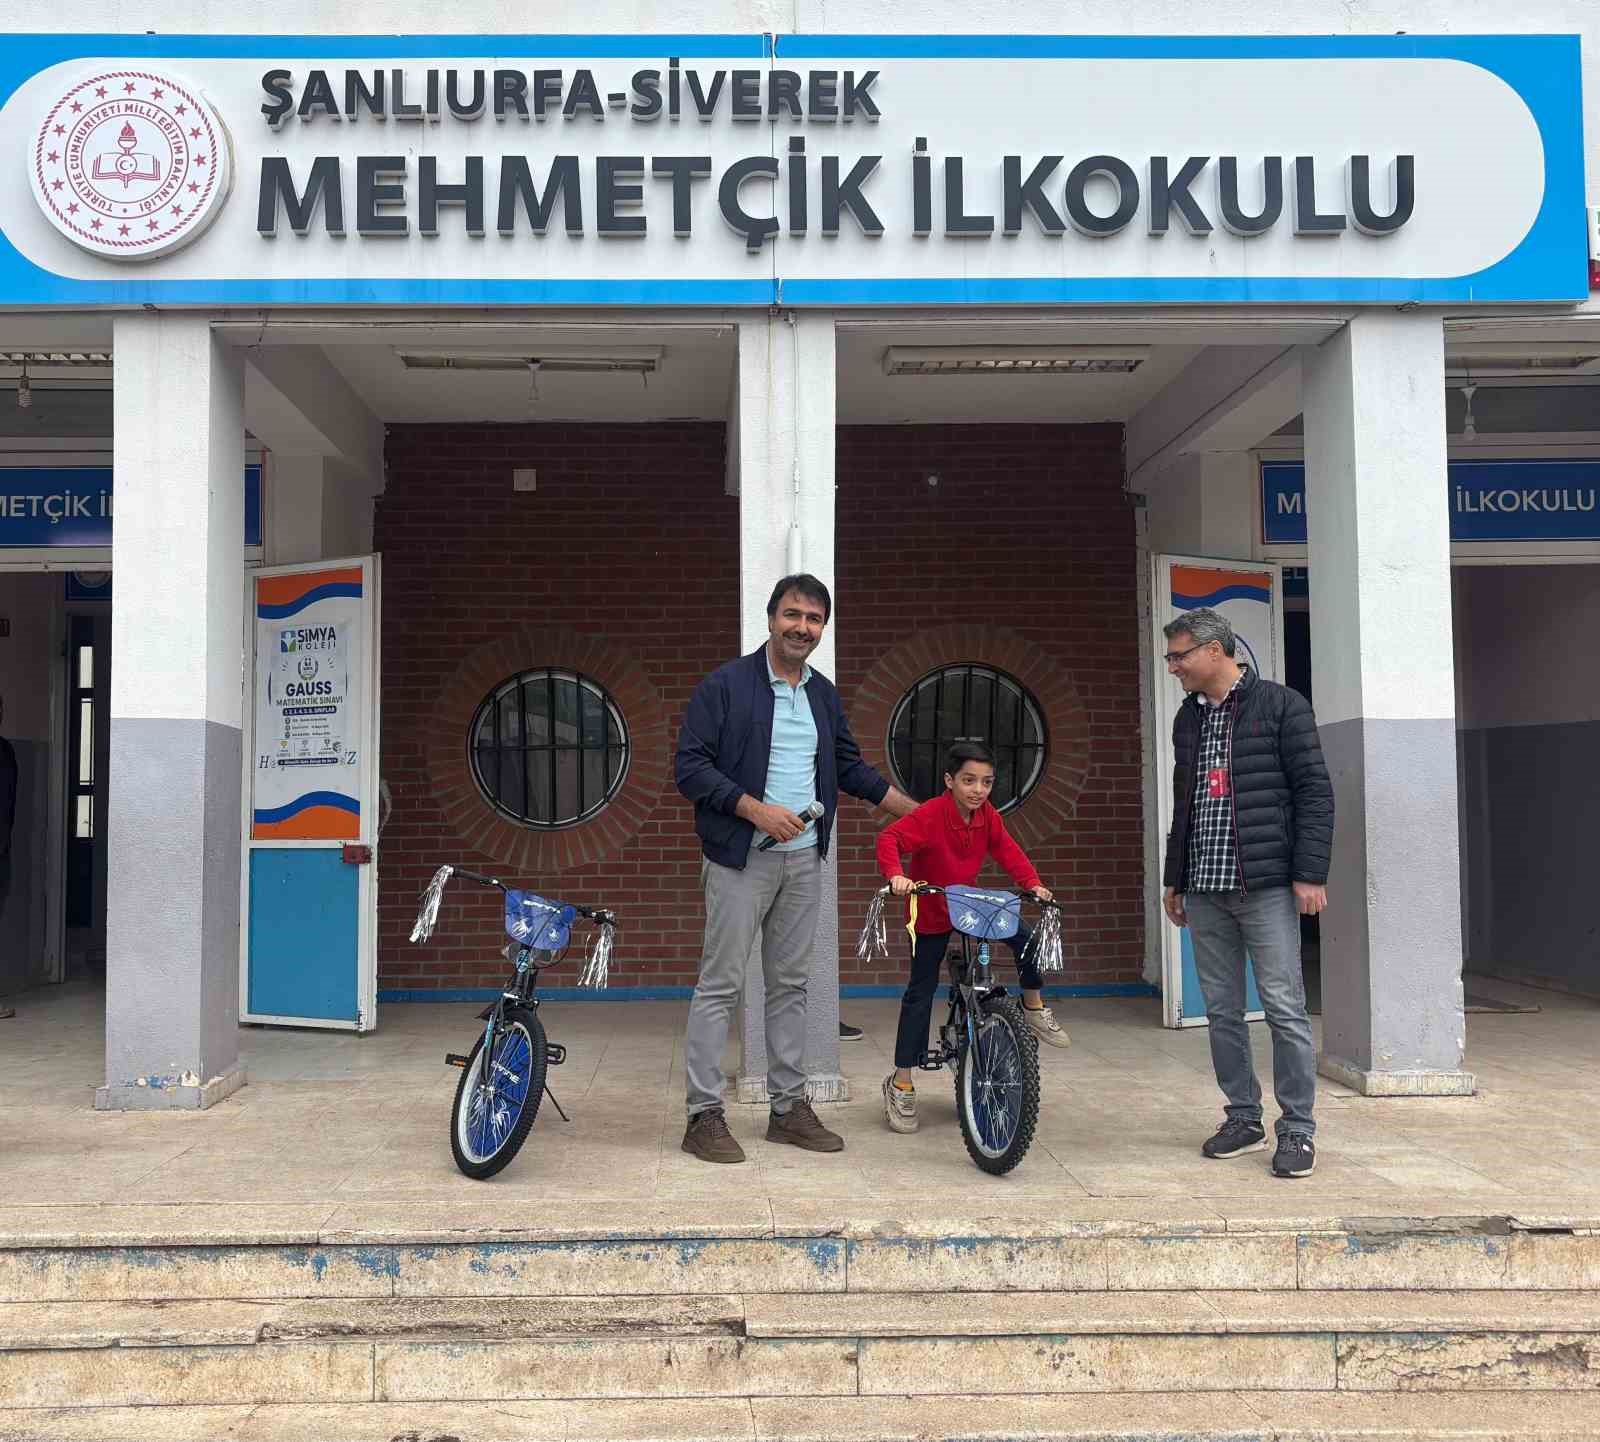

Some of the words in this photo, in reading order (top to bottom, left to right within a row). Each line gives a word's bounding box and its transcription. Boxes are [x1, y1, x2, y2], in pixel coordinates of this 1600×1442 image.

[261, 56, 882, 127] ŞANLIURFA-SİVEREK
[70, 104, 120, 170] CUMHURİYETİ
[158, 116, 184, 154] EĞİTİM
[257, 136, 885, 249] MEHMETÇİK
[912, 136, 1415, 235] İLKOKULU
[0, 490, 92, 524] ETÇİK
[1456, 485, 1595, 512] İLKOKULU
[286, 680, 332, 697] GAUSS
